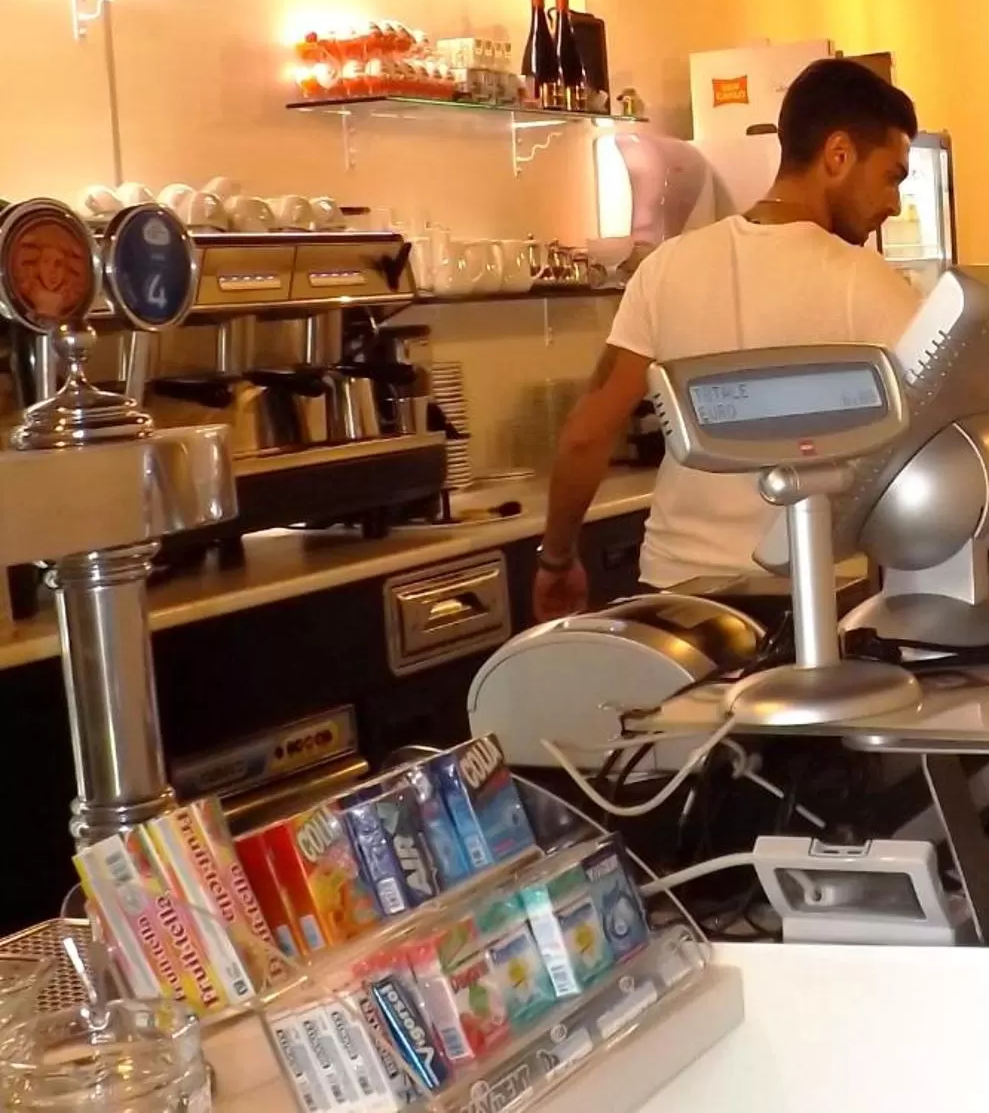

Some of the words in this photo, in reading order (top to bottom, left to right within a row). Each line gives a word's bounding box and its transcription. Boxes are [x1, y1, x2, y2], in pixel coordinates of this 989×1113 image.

[147, 273, 168, 310] 4
[393, 836, 433, 896] AIR
[380, 983, 440, 1087] Vigorsol
